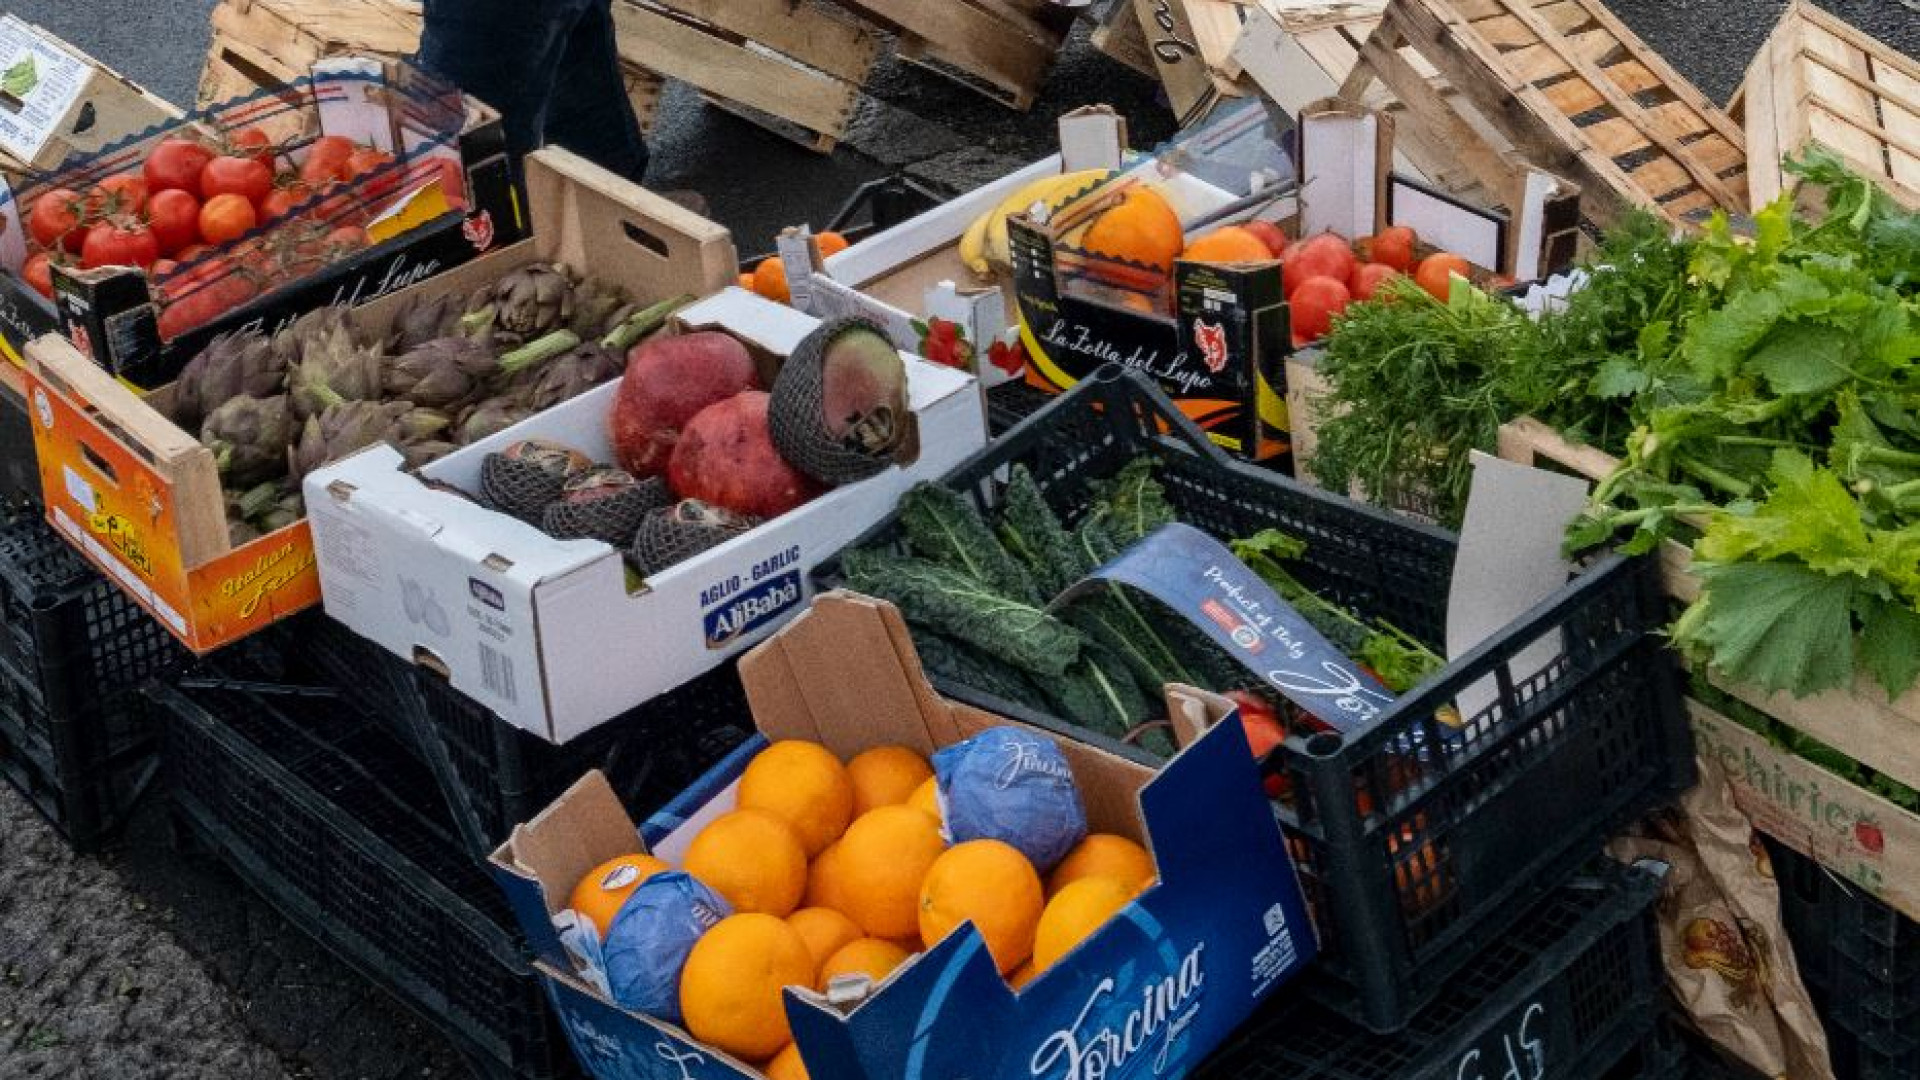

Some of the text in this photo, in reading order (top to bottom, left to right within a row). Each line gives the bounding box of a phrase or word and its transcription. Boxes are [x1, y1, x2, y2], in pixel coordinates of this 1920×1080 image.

[1124, 345, 1157, 374] del
[1154, 351, 1213, 394] Lupo
[221, 542, 295, 597] Italian
[700, 575, 740, 608] AGLIO
[752, 544, 800, 581] GARLIC
[1203, 565, 1260, 611] Product
[1271, 624, 1305, 660] Italy
